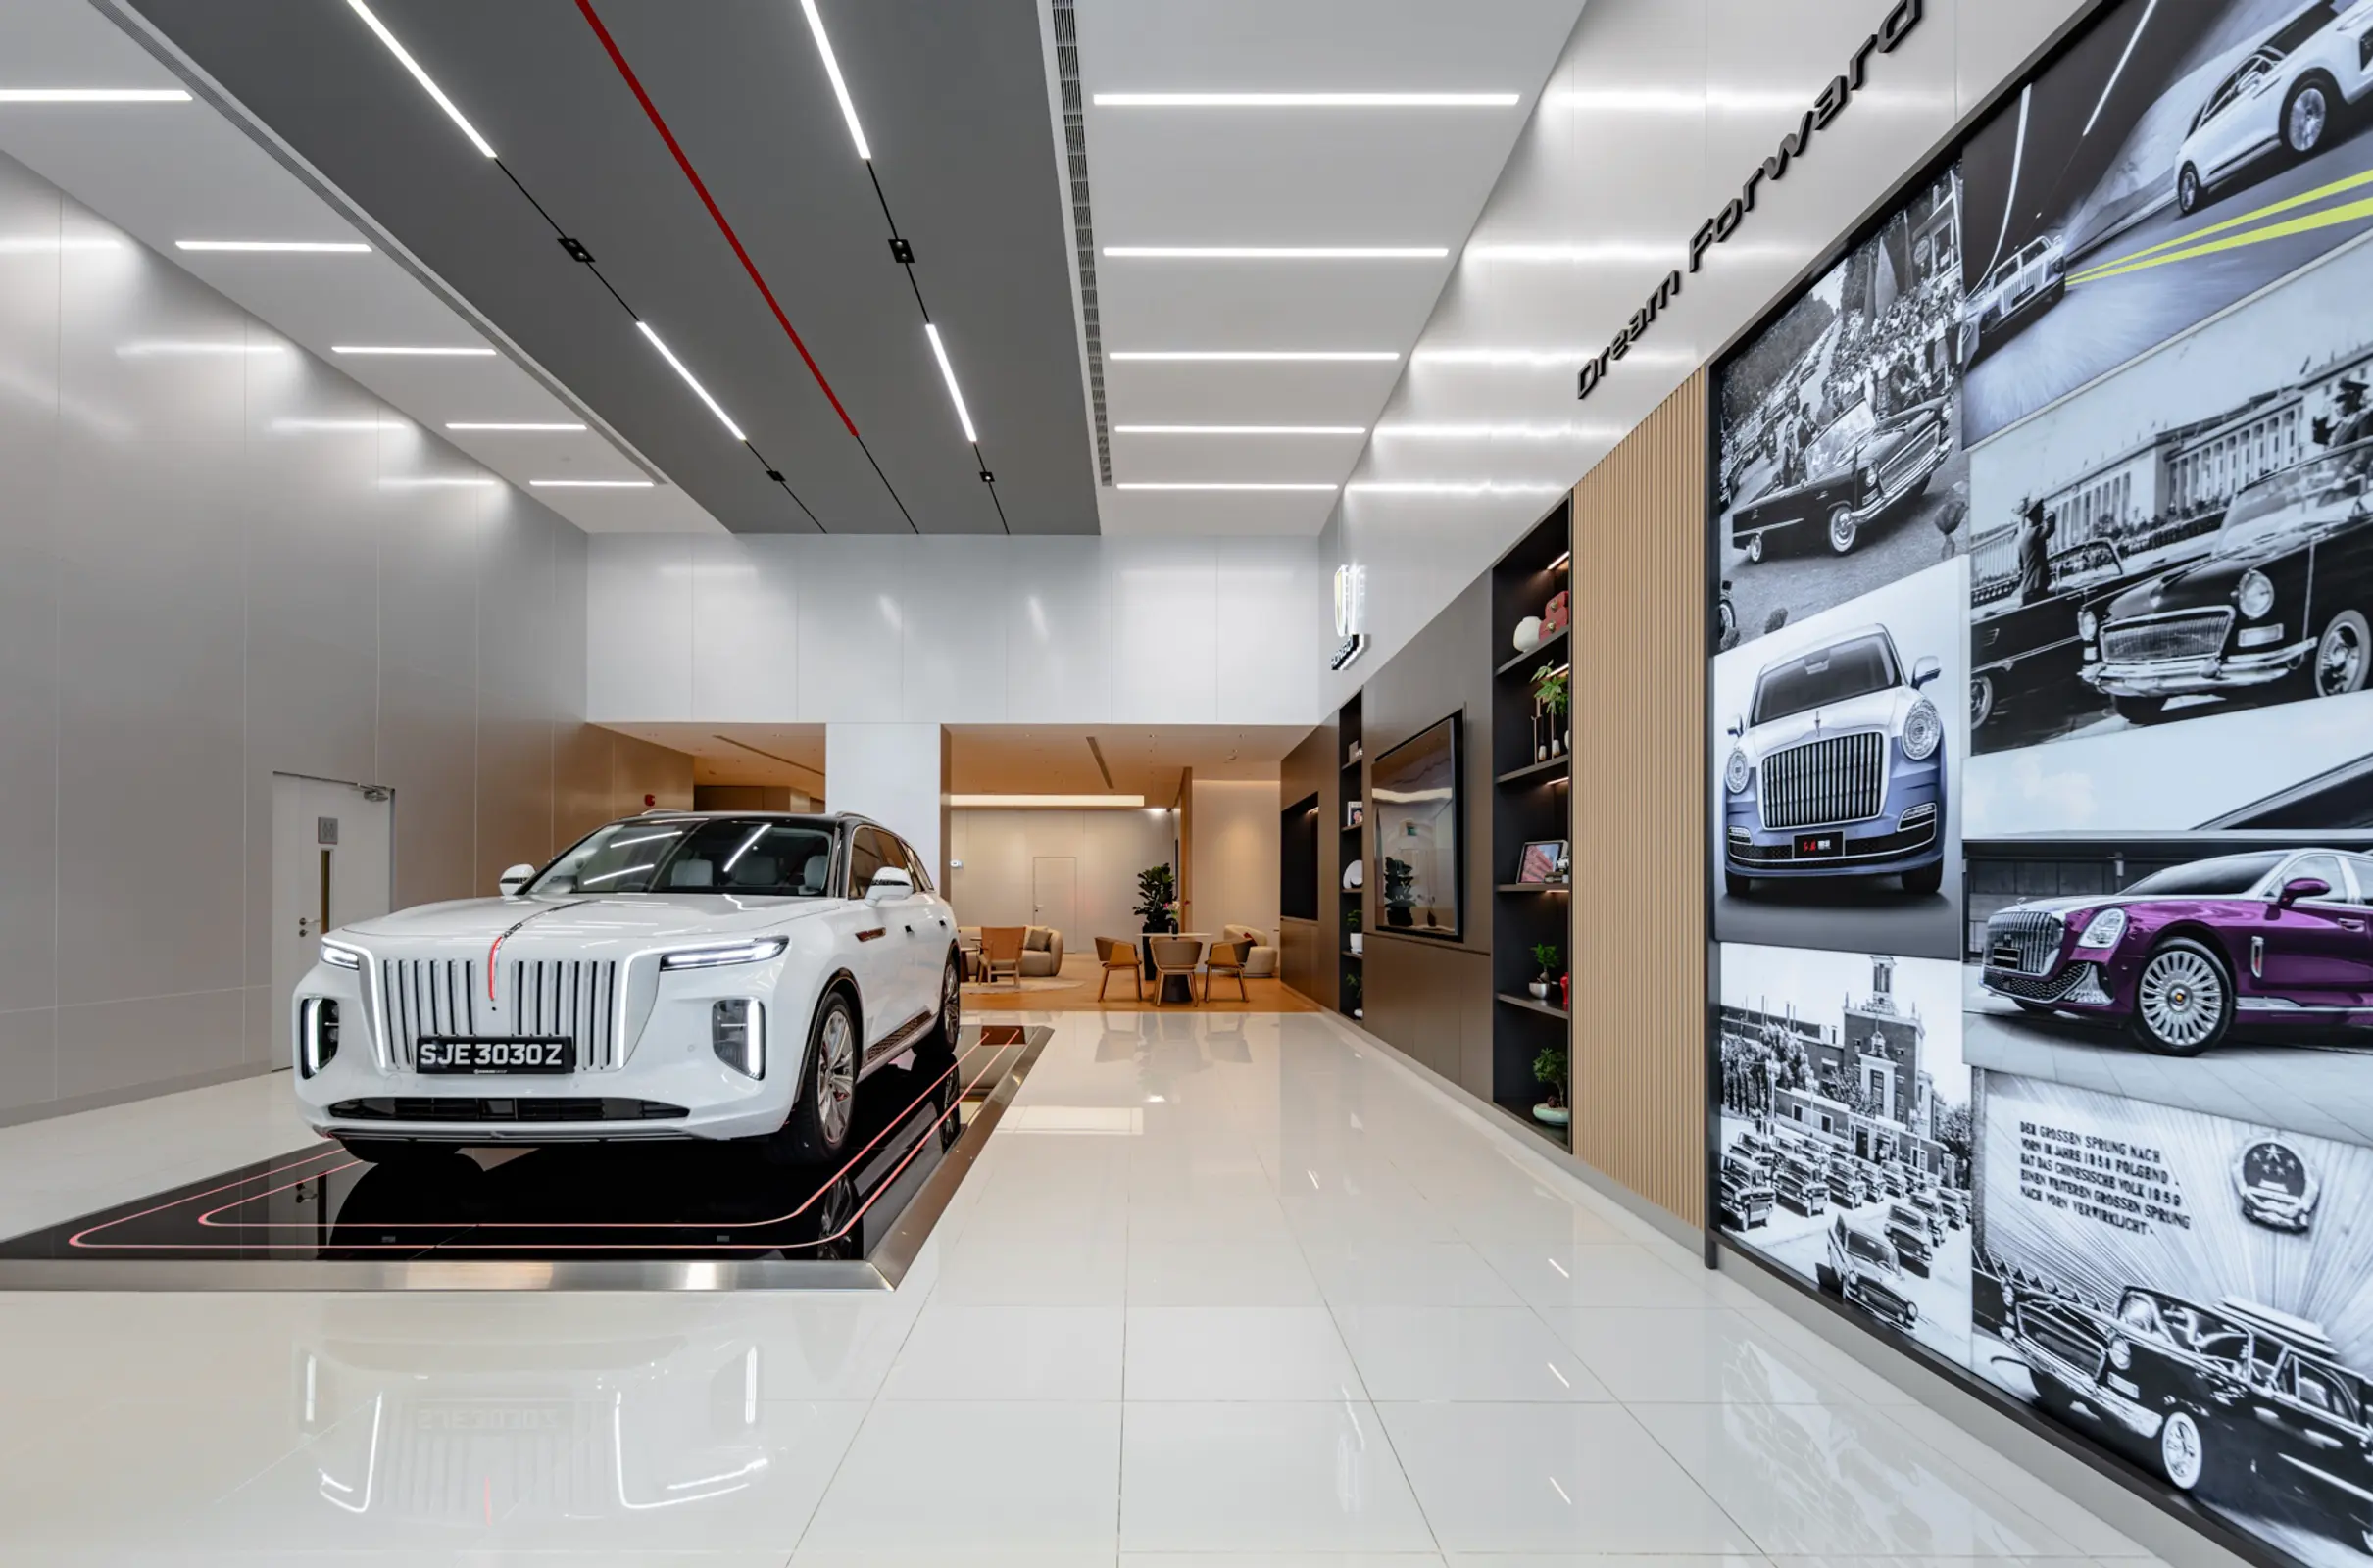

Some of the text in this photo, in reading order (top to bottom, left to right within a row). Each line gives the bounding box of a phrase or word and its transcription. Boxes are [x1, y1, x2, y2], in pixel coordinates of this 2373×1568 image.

[1577, 270, 1681, 400] Dream
[420, 1043, 563, 1065] SJE 3030 Z
[2040, 1126, 2082, 1146] GROSSEN
[2085, 1135, 2126, 1156] SPRUNG
[2130, 1144, 2161, 1164] NACH
[2054, 1146, 2080, 1163] JAHRE
[2037, 1157, 2052, 1172] DAS
[2054, 1162, 2116, 1189] CHINESISCHE
[2118, 1177, 2145, 1198] VOLK
[2020, 1168, 2191, 1230] EINEN WEITEREN GROSSEN SPRUNG
